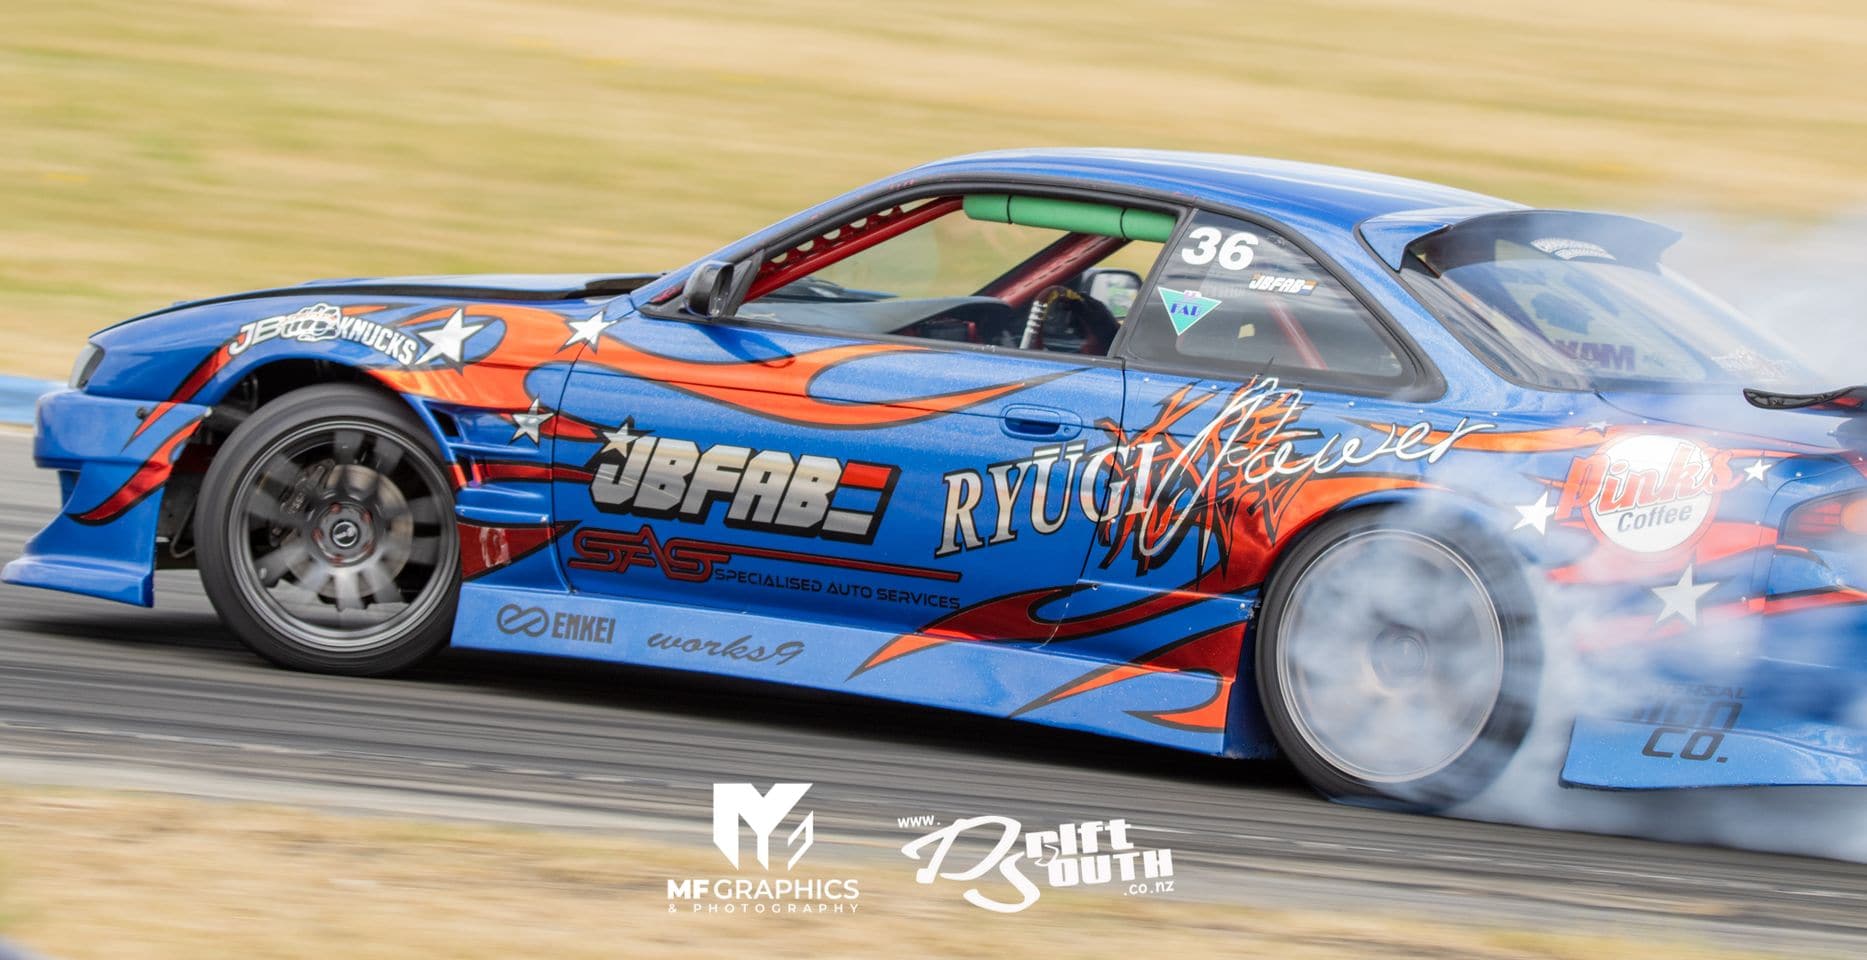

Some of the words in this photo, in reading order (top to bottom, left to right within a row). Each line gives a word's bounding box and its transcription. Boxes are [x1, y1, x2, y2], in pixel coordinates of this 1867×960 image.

[1182, 227, 1259, 271] 36
[339, 315, 418, 366] KNUCKS
[589, 433, 845, 536] JBFAB
[1139, 376, 1497, 557] Power
[1553, 441, 1745, 521] Pinks
[1617, 503, 1693, 533] Coffee
[713, 567, 823, 595] SPECIALISED
[826, 580, 873, 600] AUTO
[876, 587, 961, 610] SERVICES
[551, 612, 617, 645] ENKEI
[647, 633, 806, 667] works9
[1642, 727, 1729, 764] CO.
